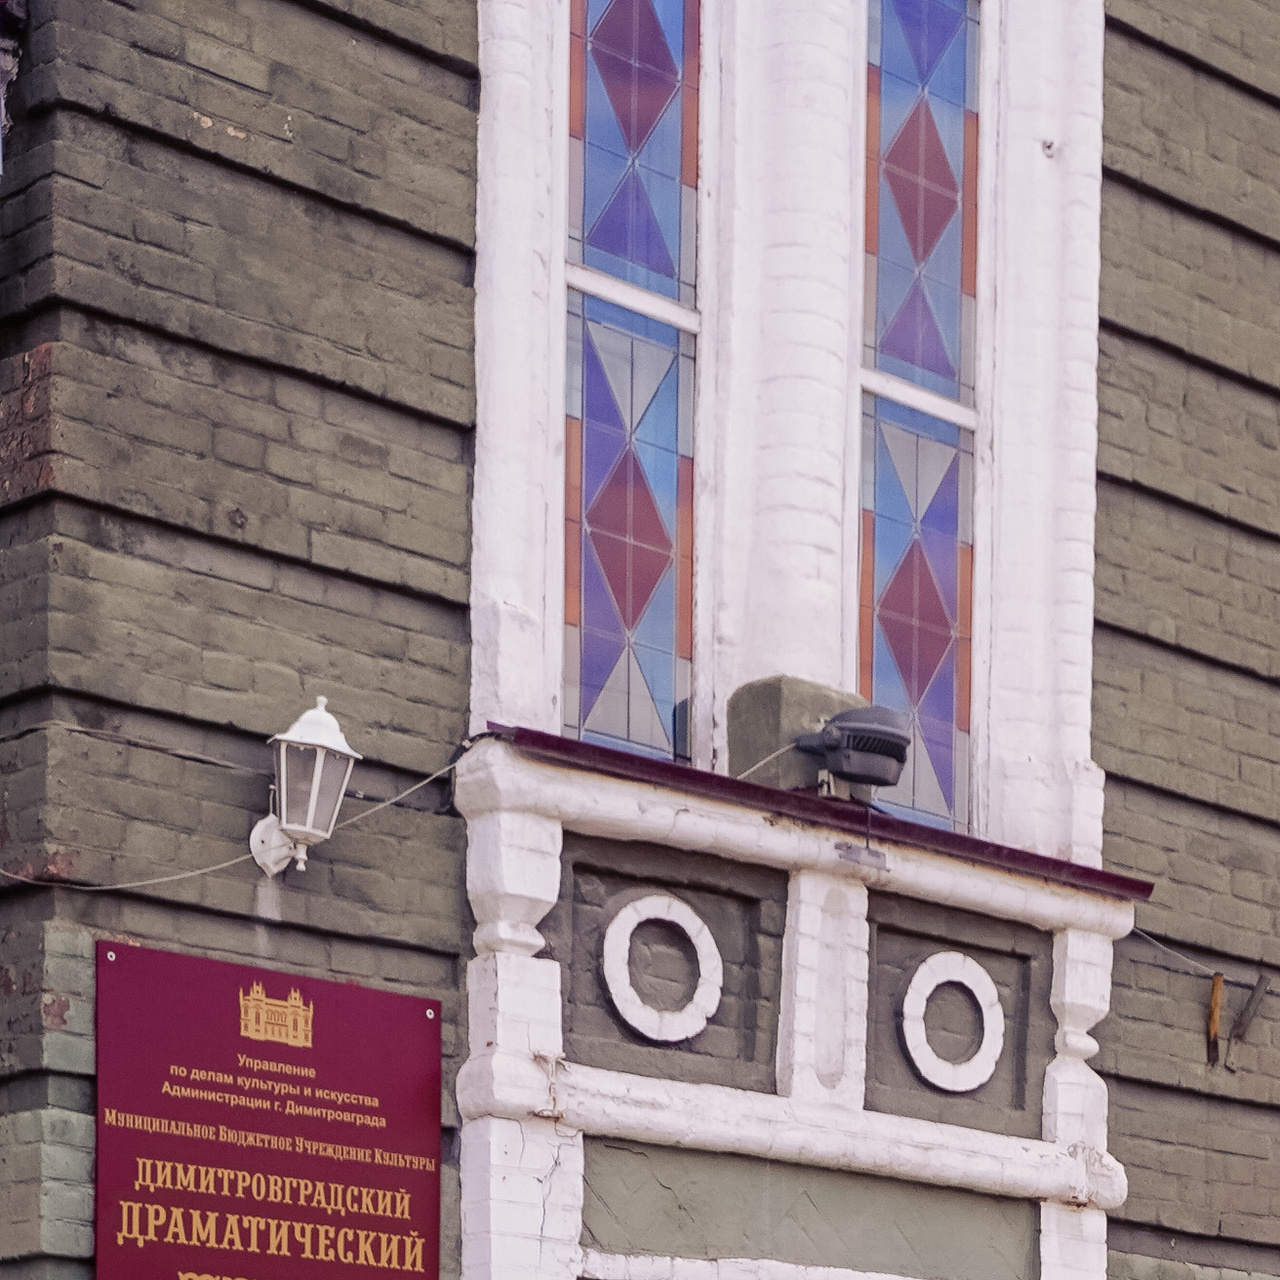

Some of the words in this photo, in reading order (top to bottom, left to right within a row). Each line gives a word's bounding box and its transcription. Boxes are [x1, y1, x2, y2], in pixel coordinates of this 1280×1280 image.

[170, 1065, 187, 1077] по
[190, 1068, 234, 1084] делам
[237, 1075, 301, 1096] культуры
[304, 1086, 312, 1096] и
[315, 1088, 380, 1107] искусства
[237, 1053, 317, 1079] Управление
[161, 1081, 271, 1111] Администрации
[274, 1101, 282, 1112] г.
[285, 1101, 387, 1128] Димитровграда
[134, 1157, 412, 1220] ДИМИТРОВГРАДСКИЙ
[116, 1200, 426, 1272] ДРАМАТИЧЕСКИЙ
